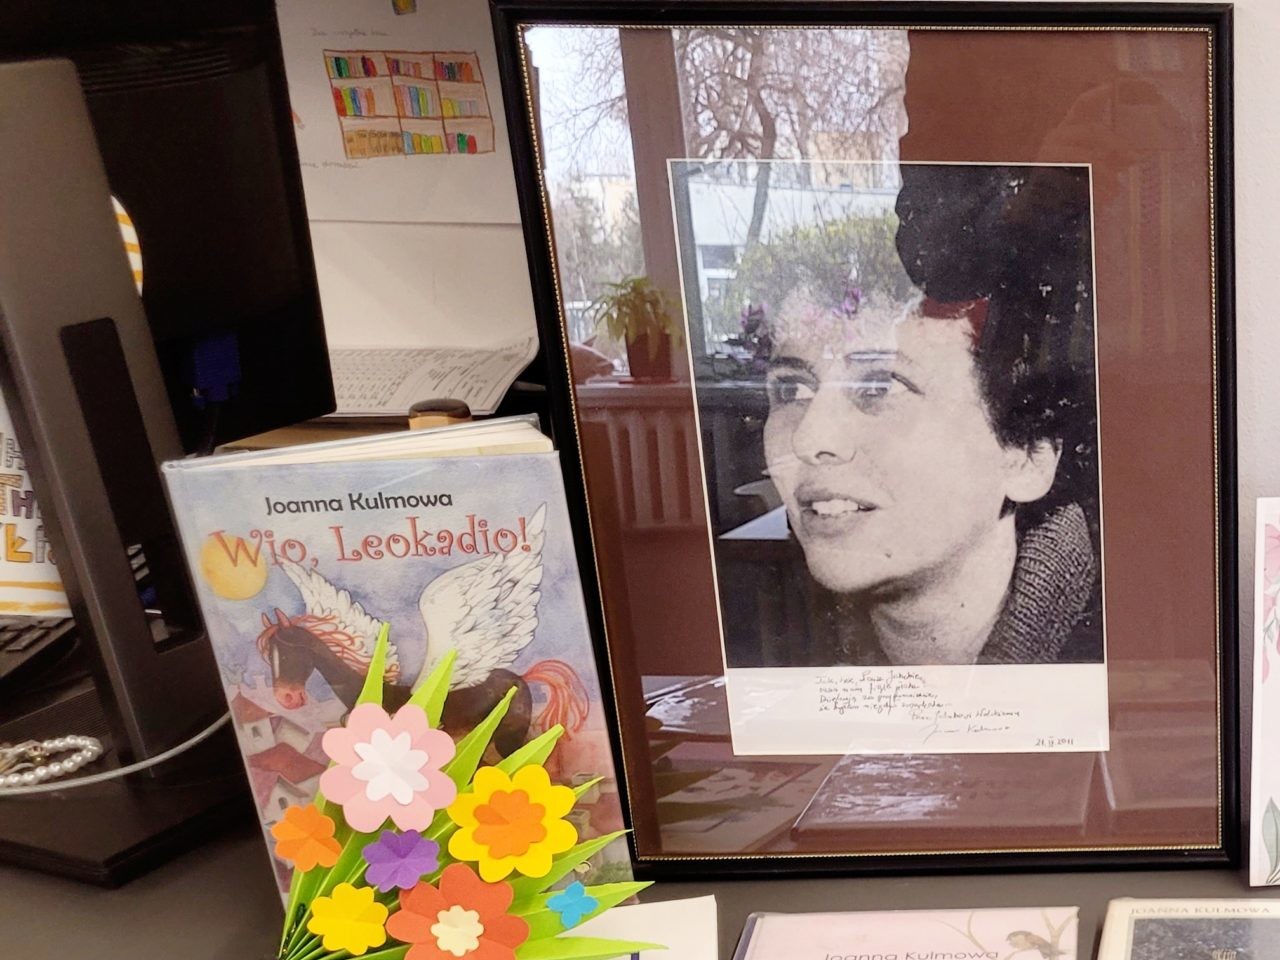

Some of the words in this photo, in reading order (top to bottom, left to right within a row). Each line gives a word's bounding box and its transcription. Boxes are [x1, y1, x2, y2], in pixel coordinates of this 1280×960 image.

[266, 496, 343, 516] Joanna
[348, 491, 453, 511] Kulmowa
[210, 529, 319, 568] Wio,
[328, 514, 532, 562] Leokadio!
[1130, 906, 1191, 915] JOANNA
[1194, 906, 1271, 914] KULMOWA
